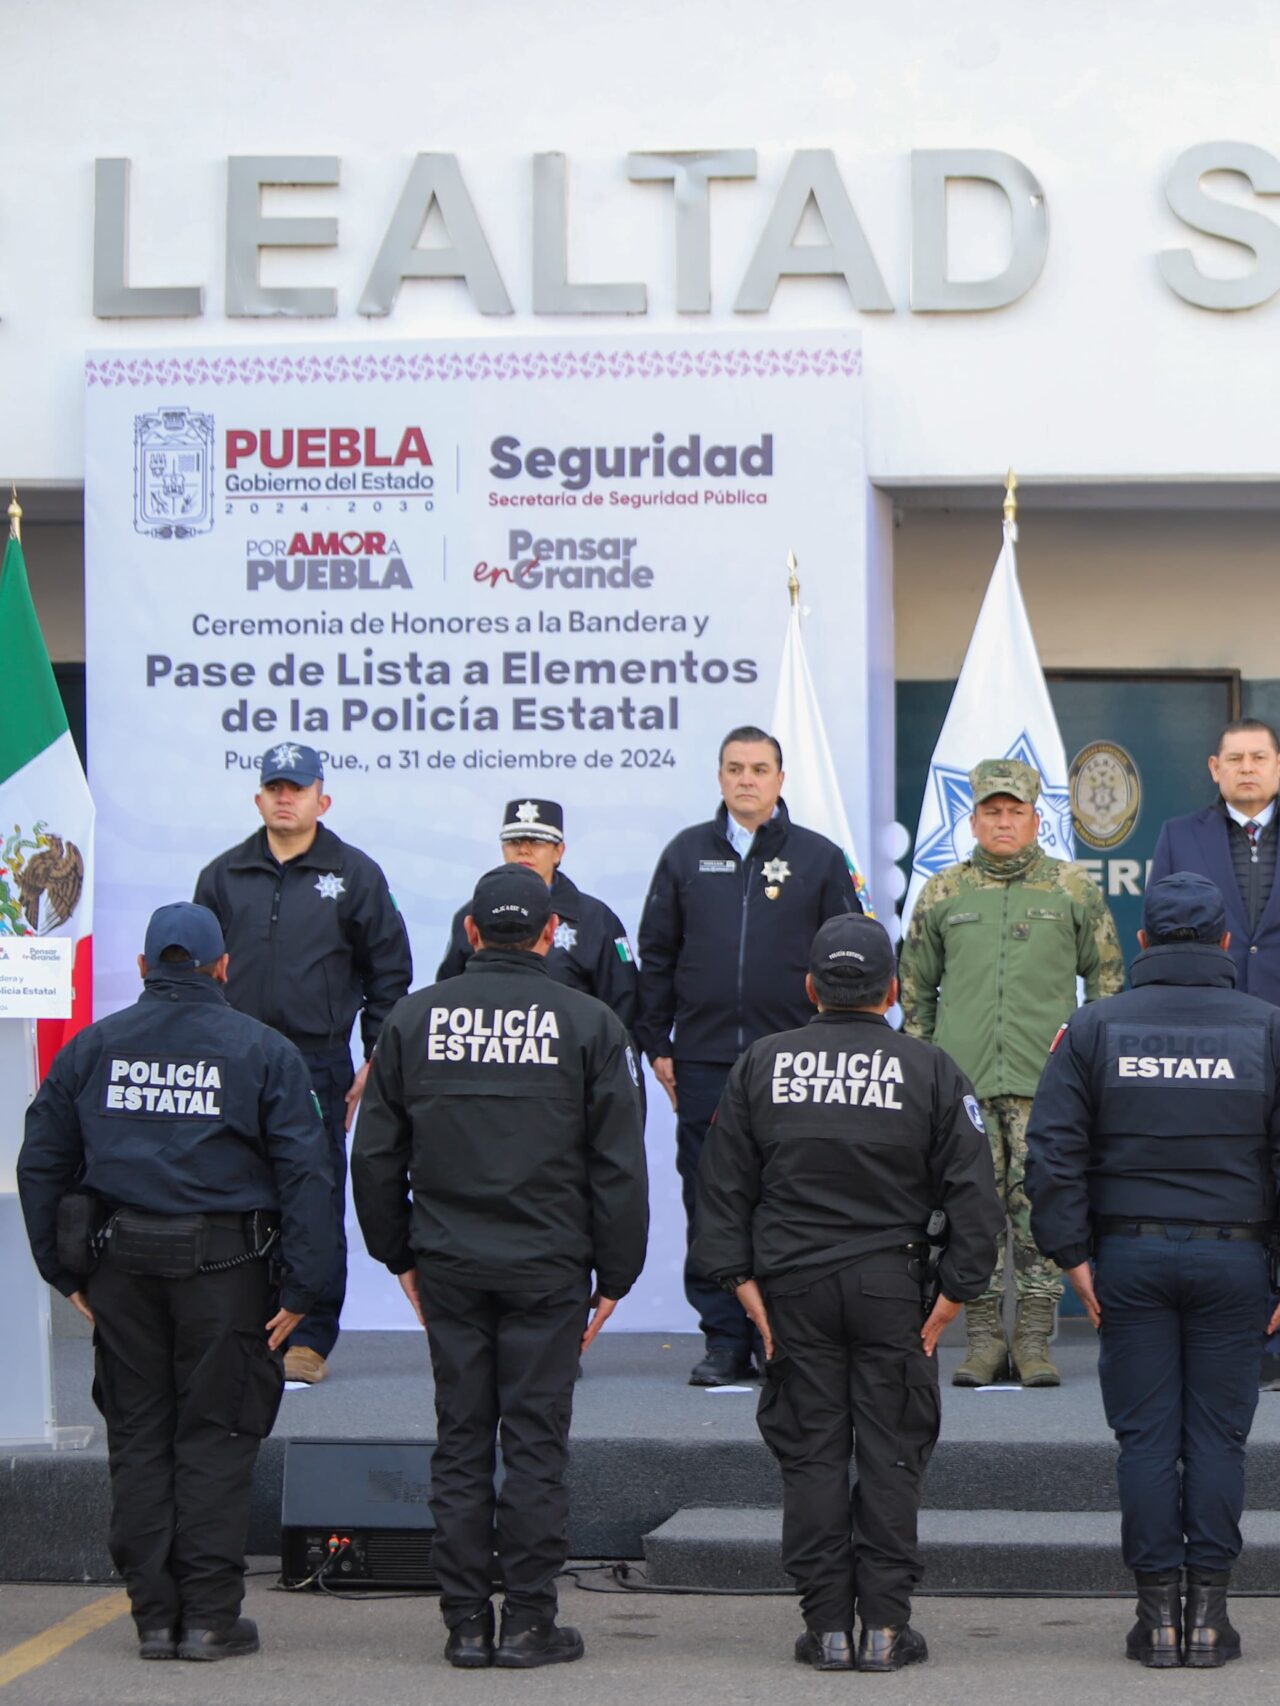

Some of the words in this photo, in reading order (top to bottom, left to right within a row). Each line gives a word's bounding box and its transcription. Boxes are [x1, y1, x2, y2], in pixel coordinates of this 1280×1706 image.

[93, 148, 1050, 319] LEALTAD
[225, 427, 433, 469] PUEBLA
[488, 432, 774, 490] Seguridad
[225, 472, 321, 492] Gobierno
[325, 471, 356, 491] del
[362, 471, 434, 490] Estado
[488, 491, 577, 507] Secretaría
[582, 491, 604, 506] de
[609, 490, 699, 509] Seguridad
[704, 489, 768, 505] Pública
[246, 539, 285, 557] POR
[388, 539, 401, 555] A
[508, 529, 638, 561] Pensar
[246, 558, 413, 591] PUEBLA
[512, 557, 655, 590] Grande
[192, 611, 344, 636] Ceremonia
[350, 612, 385, 635] de
[391, 611, 510, 635] Honores
[515, 616, 532, 634] a
[538, 610, 562, 634] la
[568, 610, 687, 633] Bandera
[693, 615, 710, 638] y
[146, 654, 256, 687] Pase
[268, 653, 325, 687] de
[337, 647, 451, 686] Lista
[463, 660, 489, 685] a
[502, 650, 759, 685] Elementos
[221, 699, 278, 732] de
[290, 699, 329, 732] la
[342, 693, 499, 732] Policía
[512, 696, 679, 731] Estatal
[376, 755, 392, 769] a
[398, 750, 419, 769] 31
[426, 750, 457, 769] de
[462, 749, 577, 769] diciembre
[584, 749, 614, 769] de
[620, 748, 676, 768] 2024
[429, 1004, 560, 1039] POLICÍA
[428, 1034, 559, 1065] ESTATAL
[110, 1059, 222, 1089] POLICÍA
[773, 1049, 904, 1084] POLICÍA
[106, 1084, 221, 1116] ESTATAL
[772, 1077, 904, 1110] ESTATAL
